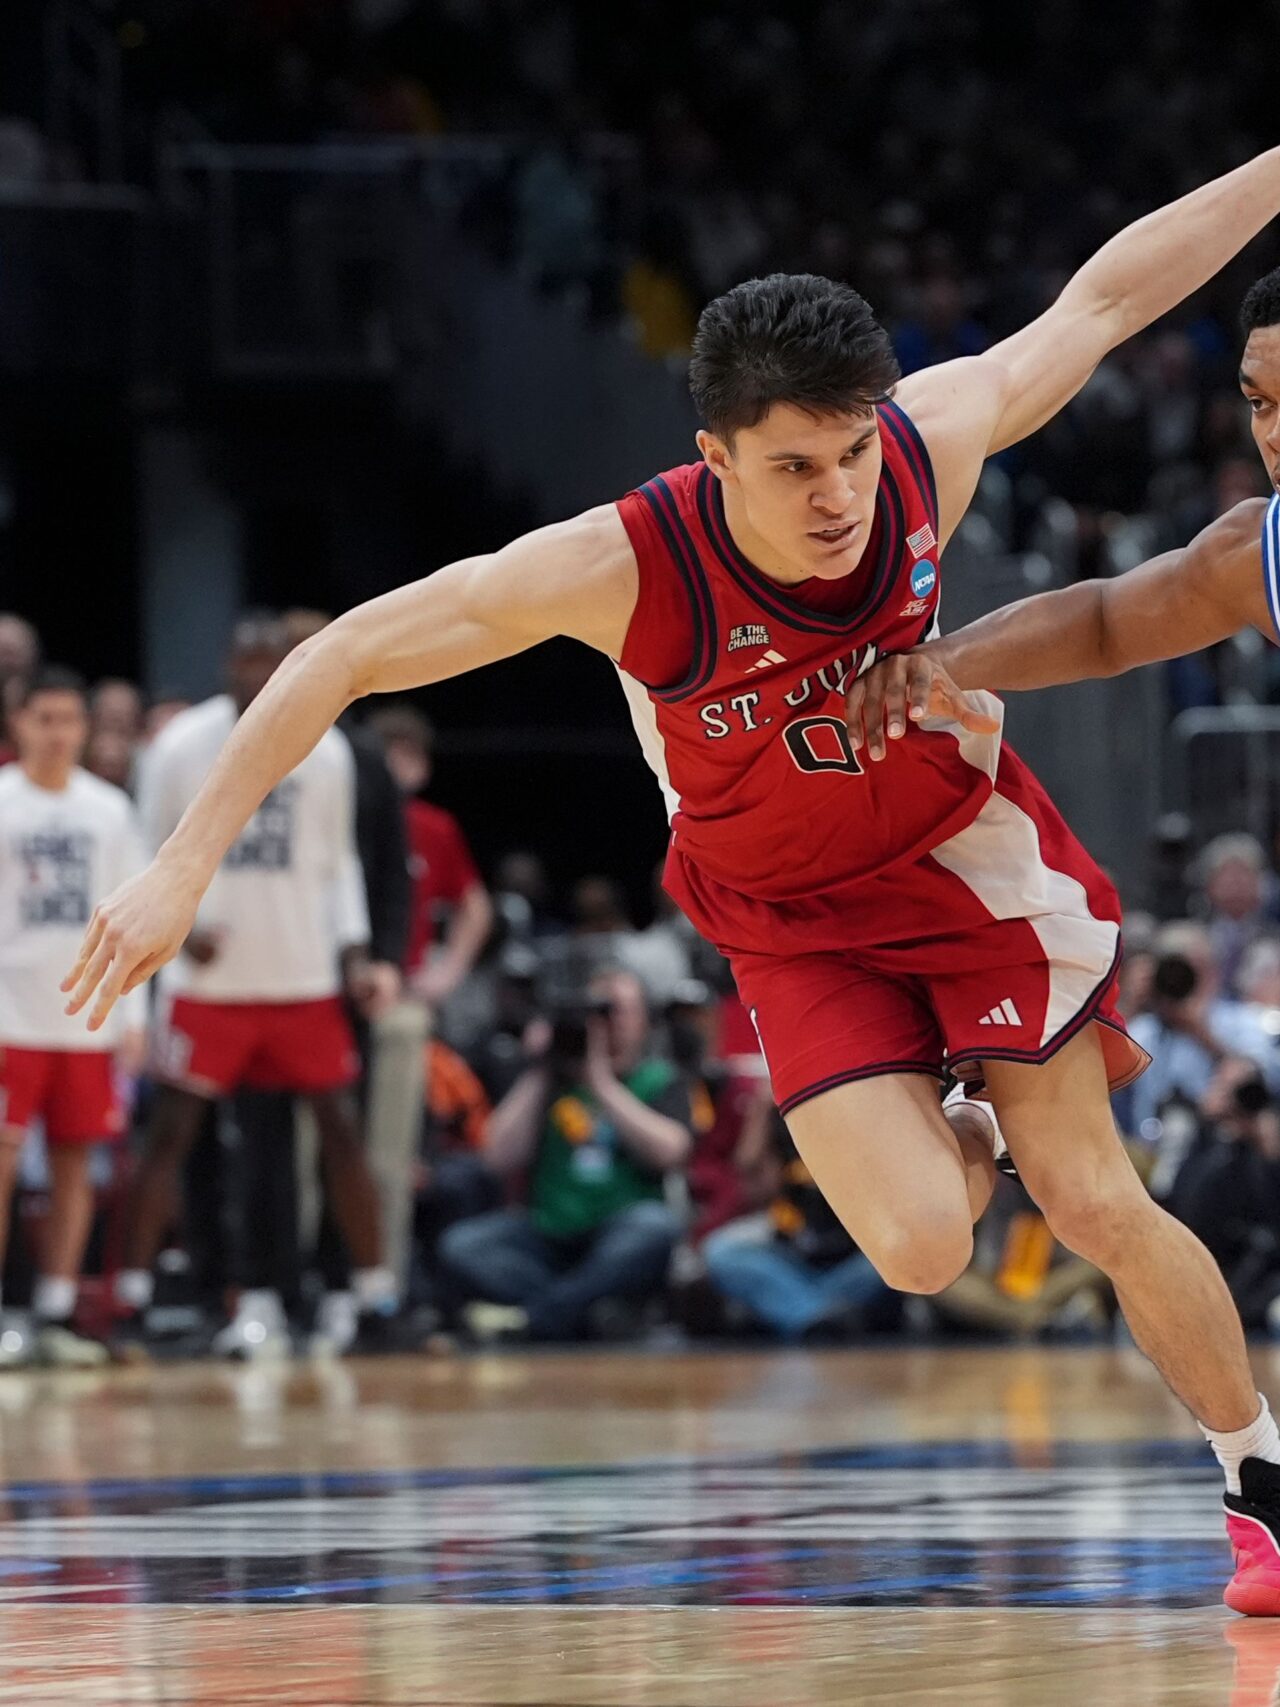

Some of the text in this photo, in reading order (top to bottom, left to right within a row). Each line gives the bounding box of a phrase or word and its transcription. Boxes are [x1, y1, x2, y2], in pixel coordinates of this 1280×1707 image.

[915, 573, 935, 591] NCAA
[730, 624, 767, 640] BE THE
[727, 634, 770, 652] CHANGE
[700, 691, 773, 738] ST.
[782, 715, 865, 775] 0
